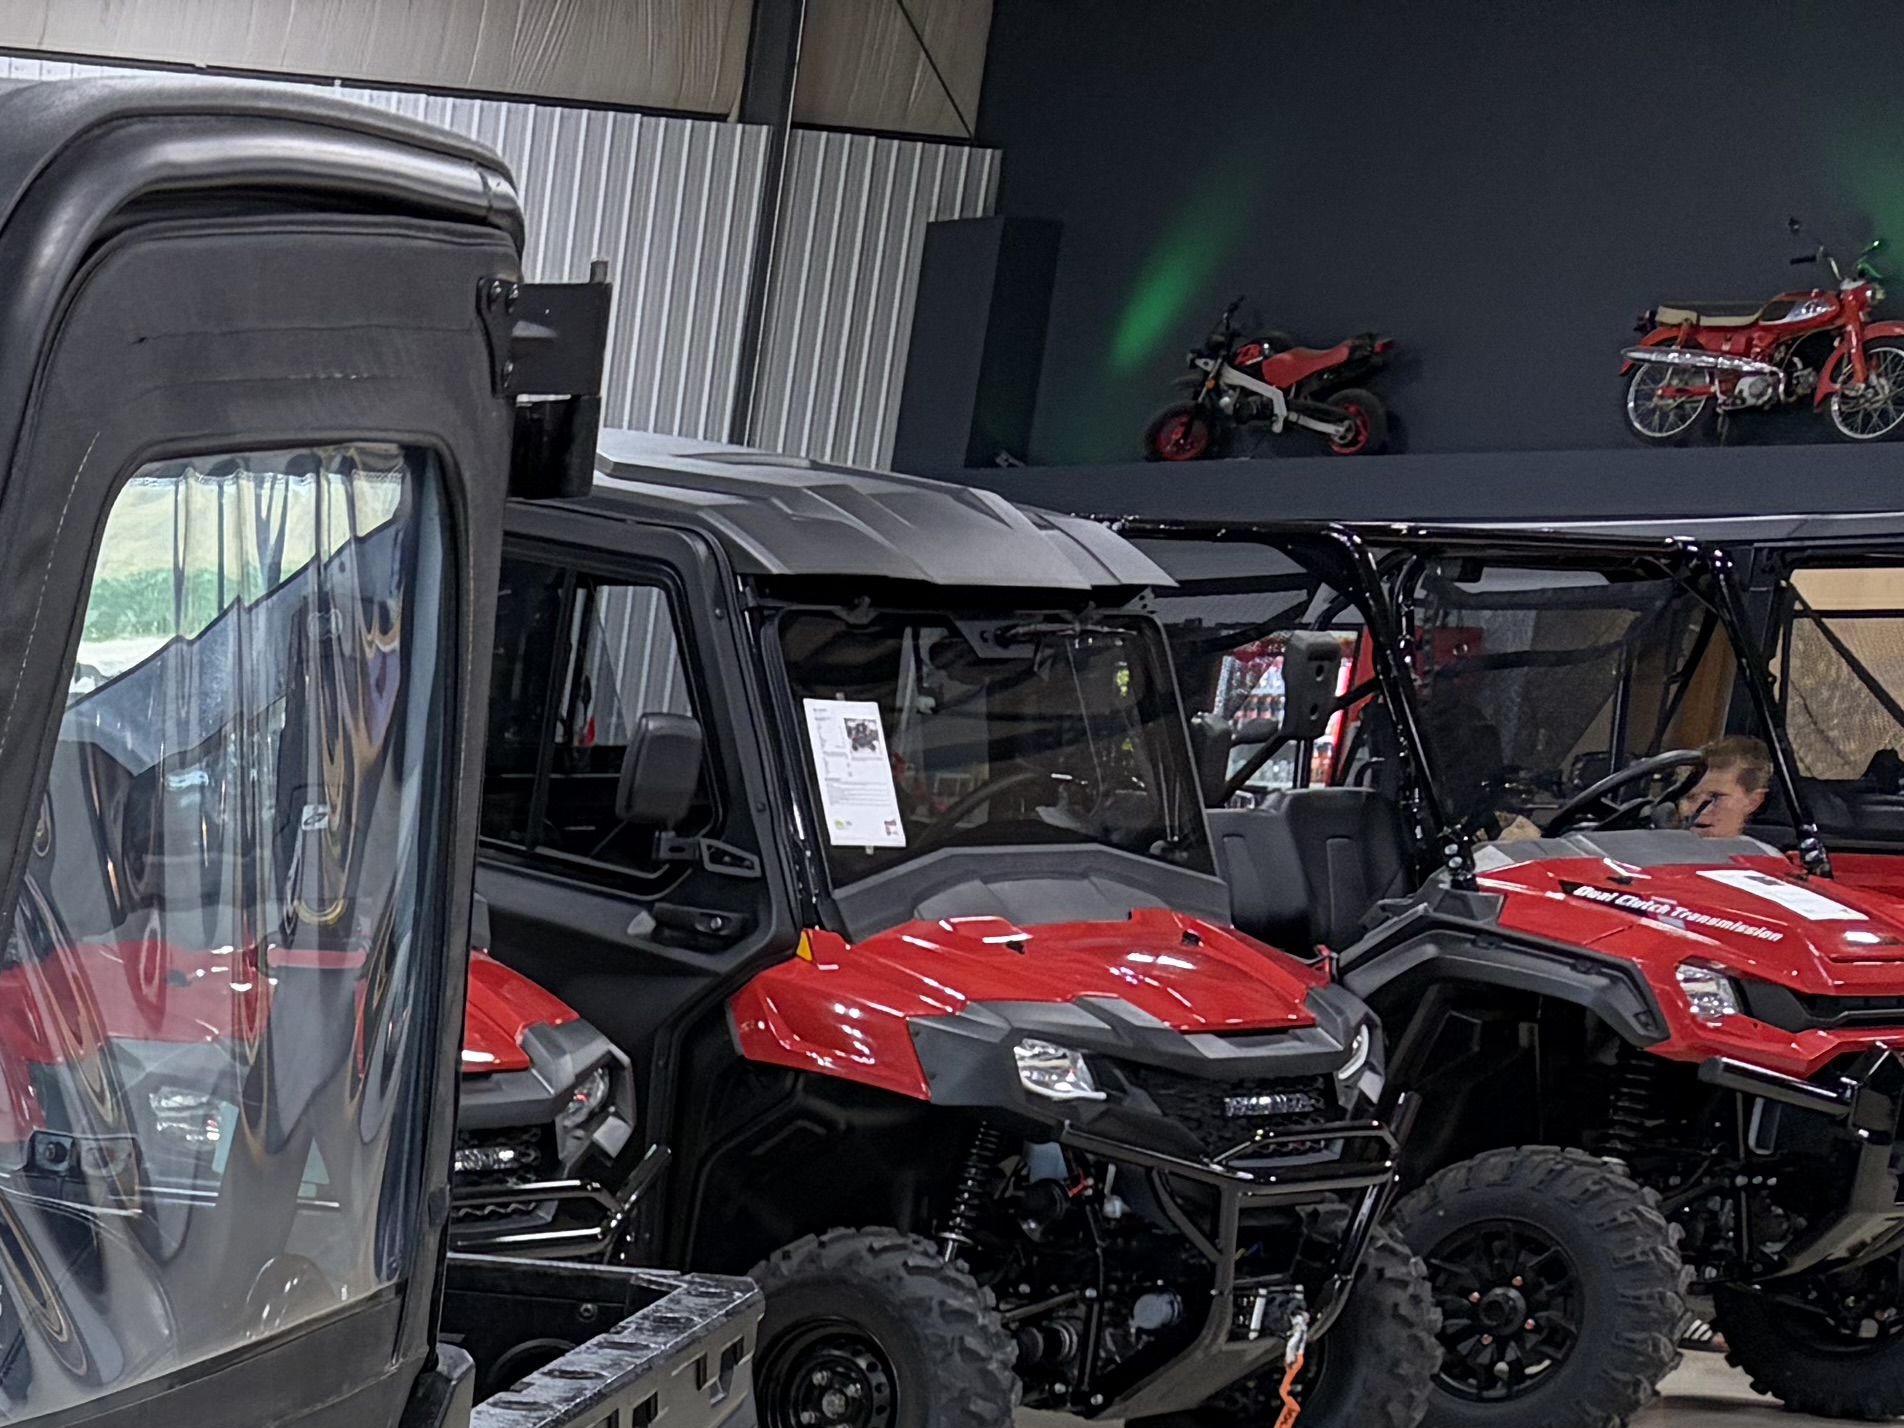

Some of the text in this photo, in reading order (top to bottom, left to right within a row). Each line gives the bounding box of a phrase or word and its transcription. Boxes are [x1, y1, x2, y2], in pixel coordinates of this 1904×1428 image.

[1573, 885, 1785, 943] Dual Clutch Transmission
